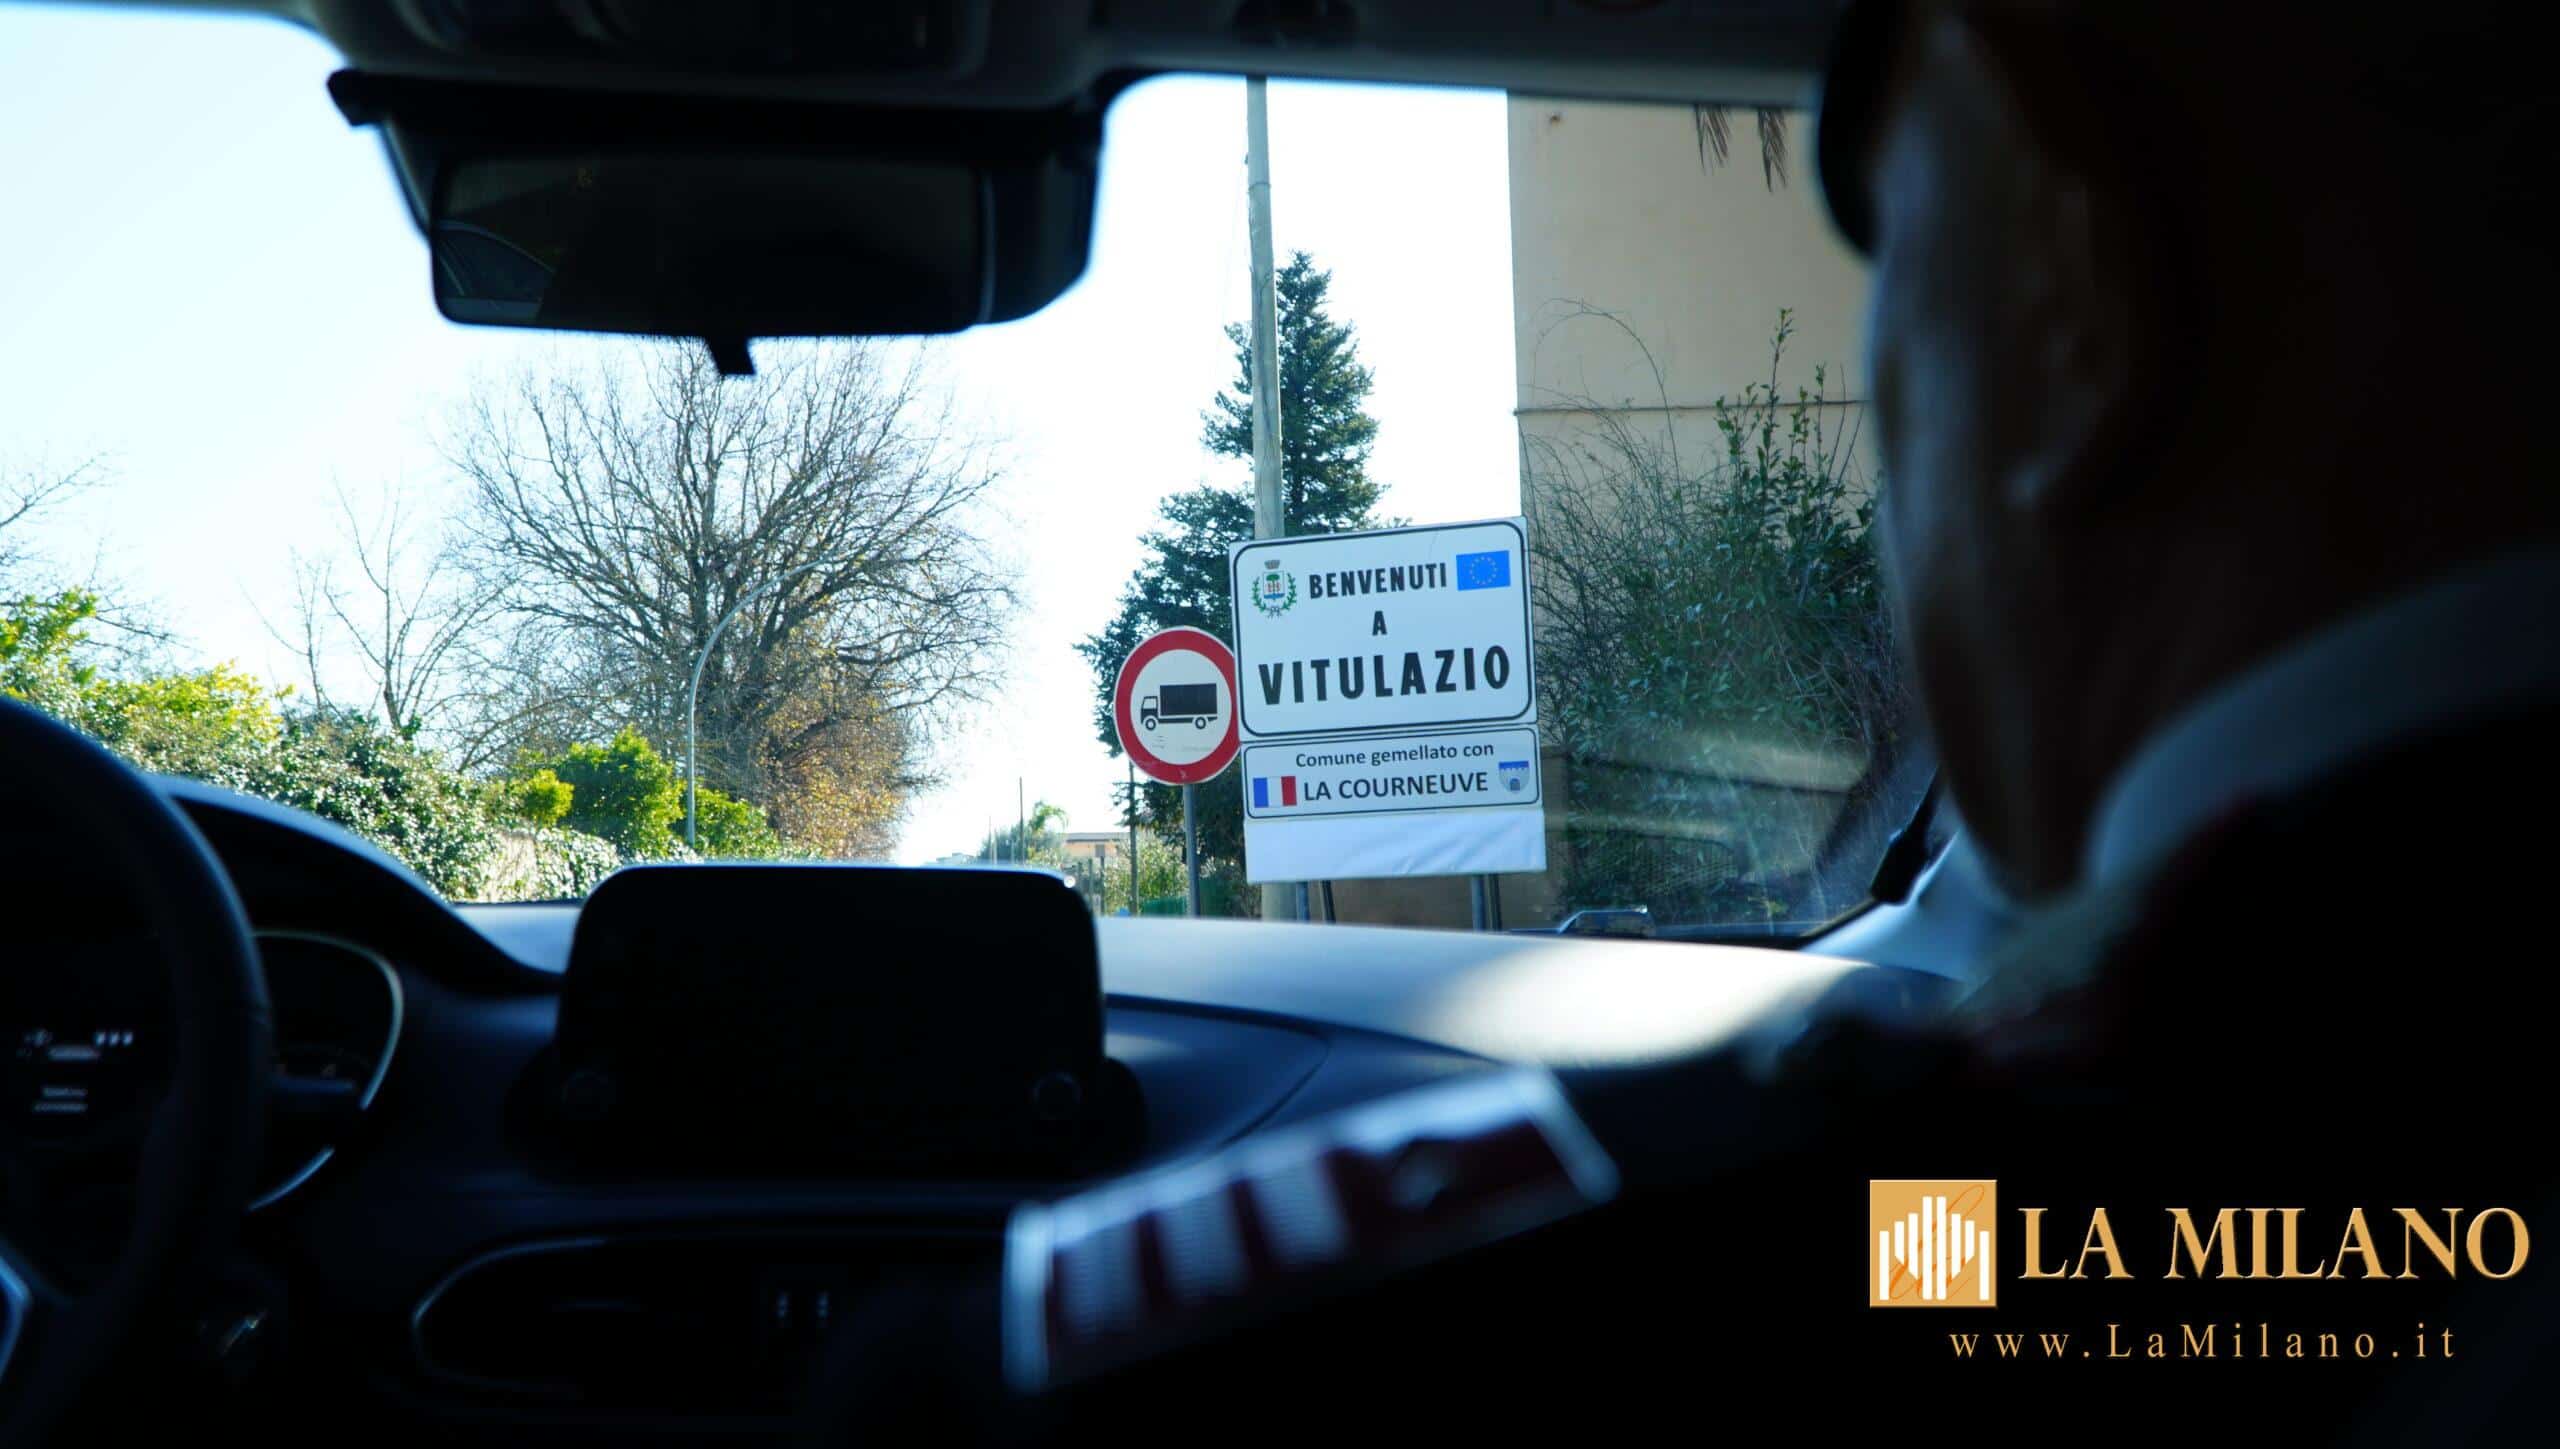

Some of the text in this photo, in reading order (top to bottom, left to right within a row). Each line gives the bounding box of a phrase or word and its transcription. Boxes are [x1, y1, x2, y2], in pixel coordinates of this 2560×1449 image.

[1309, 562, 1447, 599] BENVENUTI
[1372, 610, 1388, 636] A
[1258, 645, 1510, 706] VITULAZIO
[1295, 743, 1494, 768] Comune gemellato con
[1303, 772, 1488, 801] LA COURNEUVE
